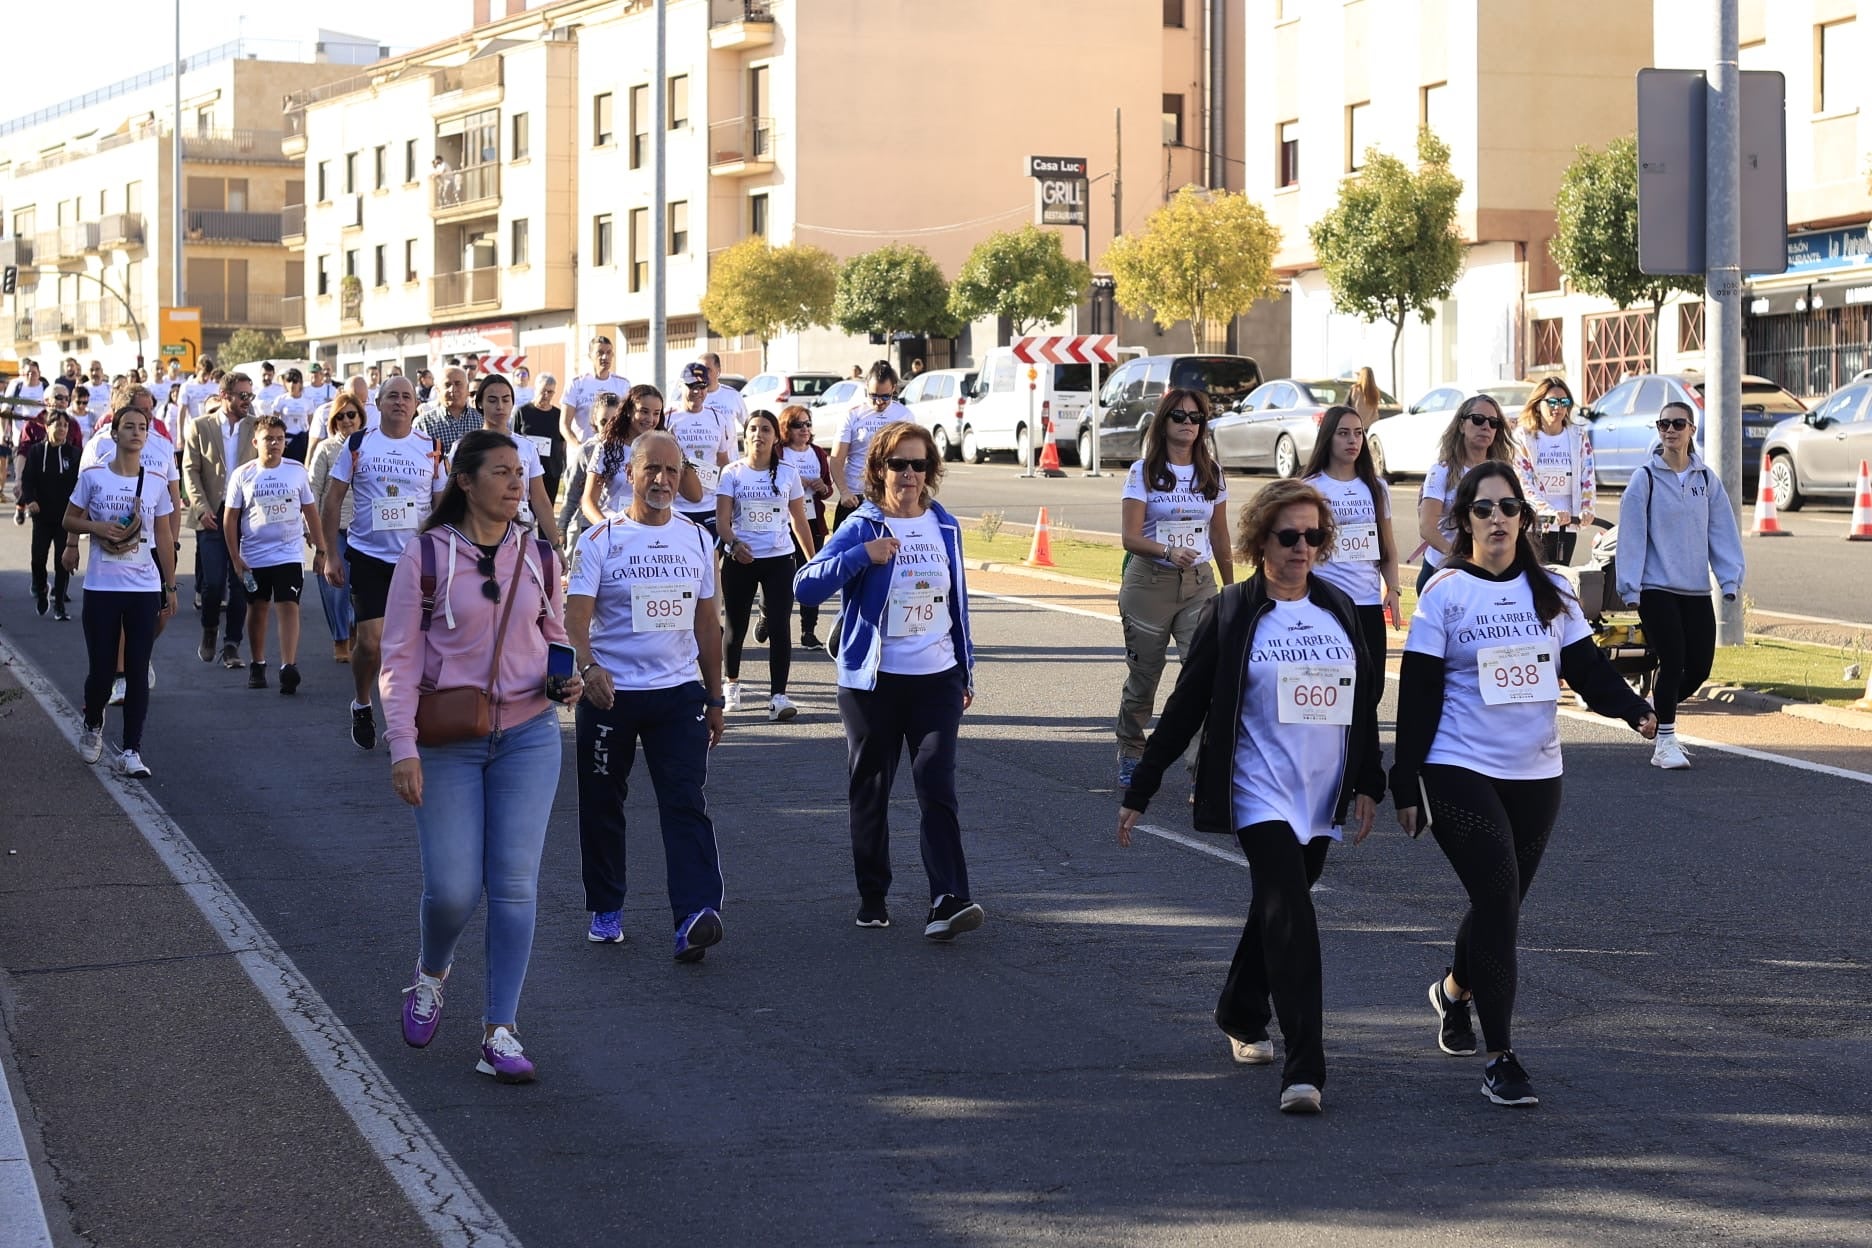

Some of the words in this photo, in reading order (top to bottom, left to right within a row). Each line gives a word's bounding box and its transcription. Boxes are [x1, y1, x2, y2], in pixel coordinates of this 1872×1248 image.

[1033, 159, 1058, 171] Casa
[1061, 161, 1085, 174] Lucy
[1043, 181, 1083, 205] GRILL
[361, 464, 400, 474] GVARDIA
[383, 458, 415, 467] CARRERA
[1543, 475, 1566, 487] 728
[264, 503, 287, 516] 796
[381, 508, 407, 520] 881
[748, 512, 773, 523] 936
[1168, 534, 1195, 548] 916
[1341, 537, 1370, 552] 904
[629, 555, 641, 565] III
[643, 554, 688, 565] CARRERA
[612, 566, 670, 580] GVARDIA
[646, 599, 683, 618] 895
[902, 603, 934, 623] 718
[1475, 614, 1489, 625] III
[1267, 639, 1281, 648] III
[1286, 634, 1342, 647] CARRERA
[1458, 624, 1522, 644] GVARDIA
[1249, 648, 1321, 663] GVARDIA
[1494, 663, 1540, 688] 938
[1293, 684, 1338, 707] 660
